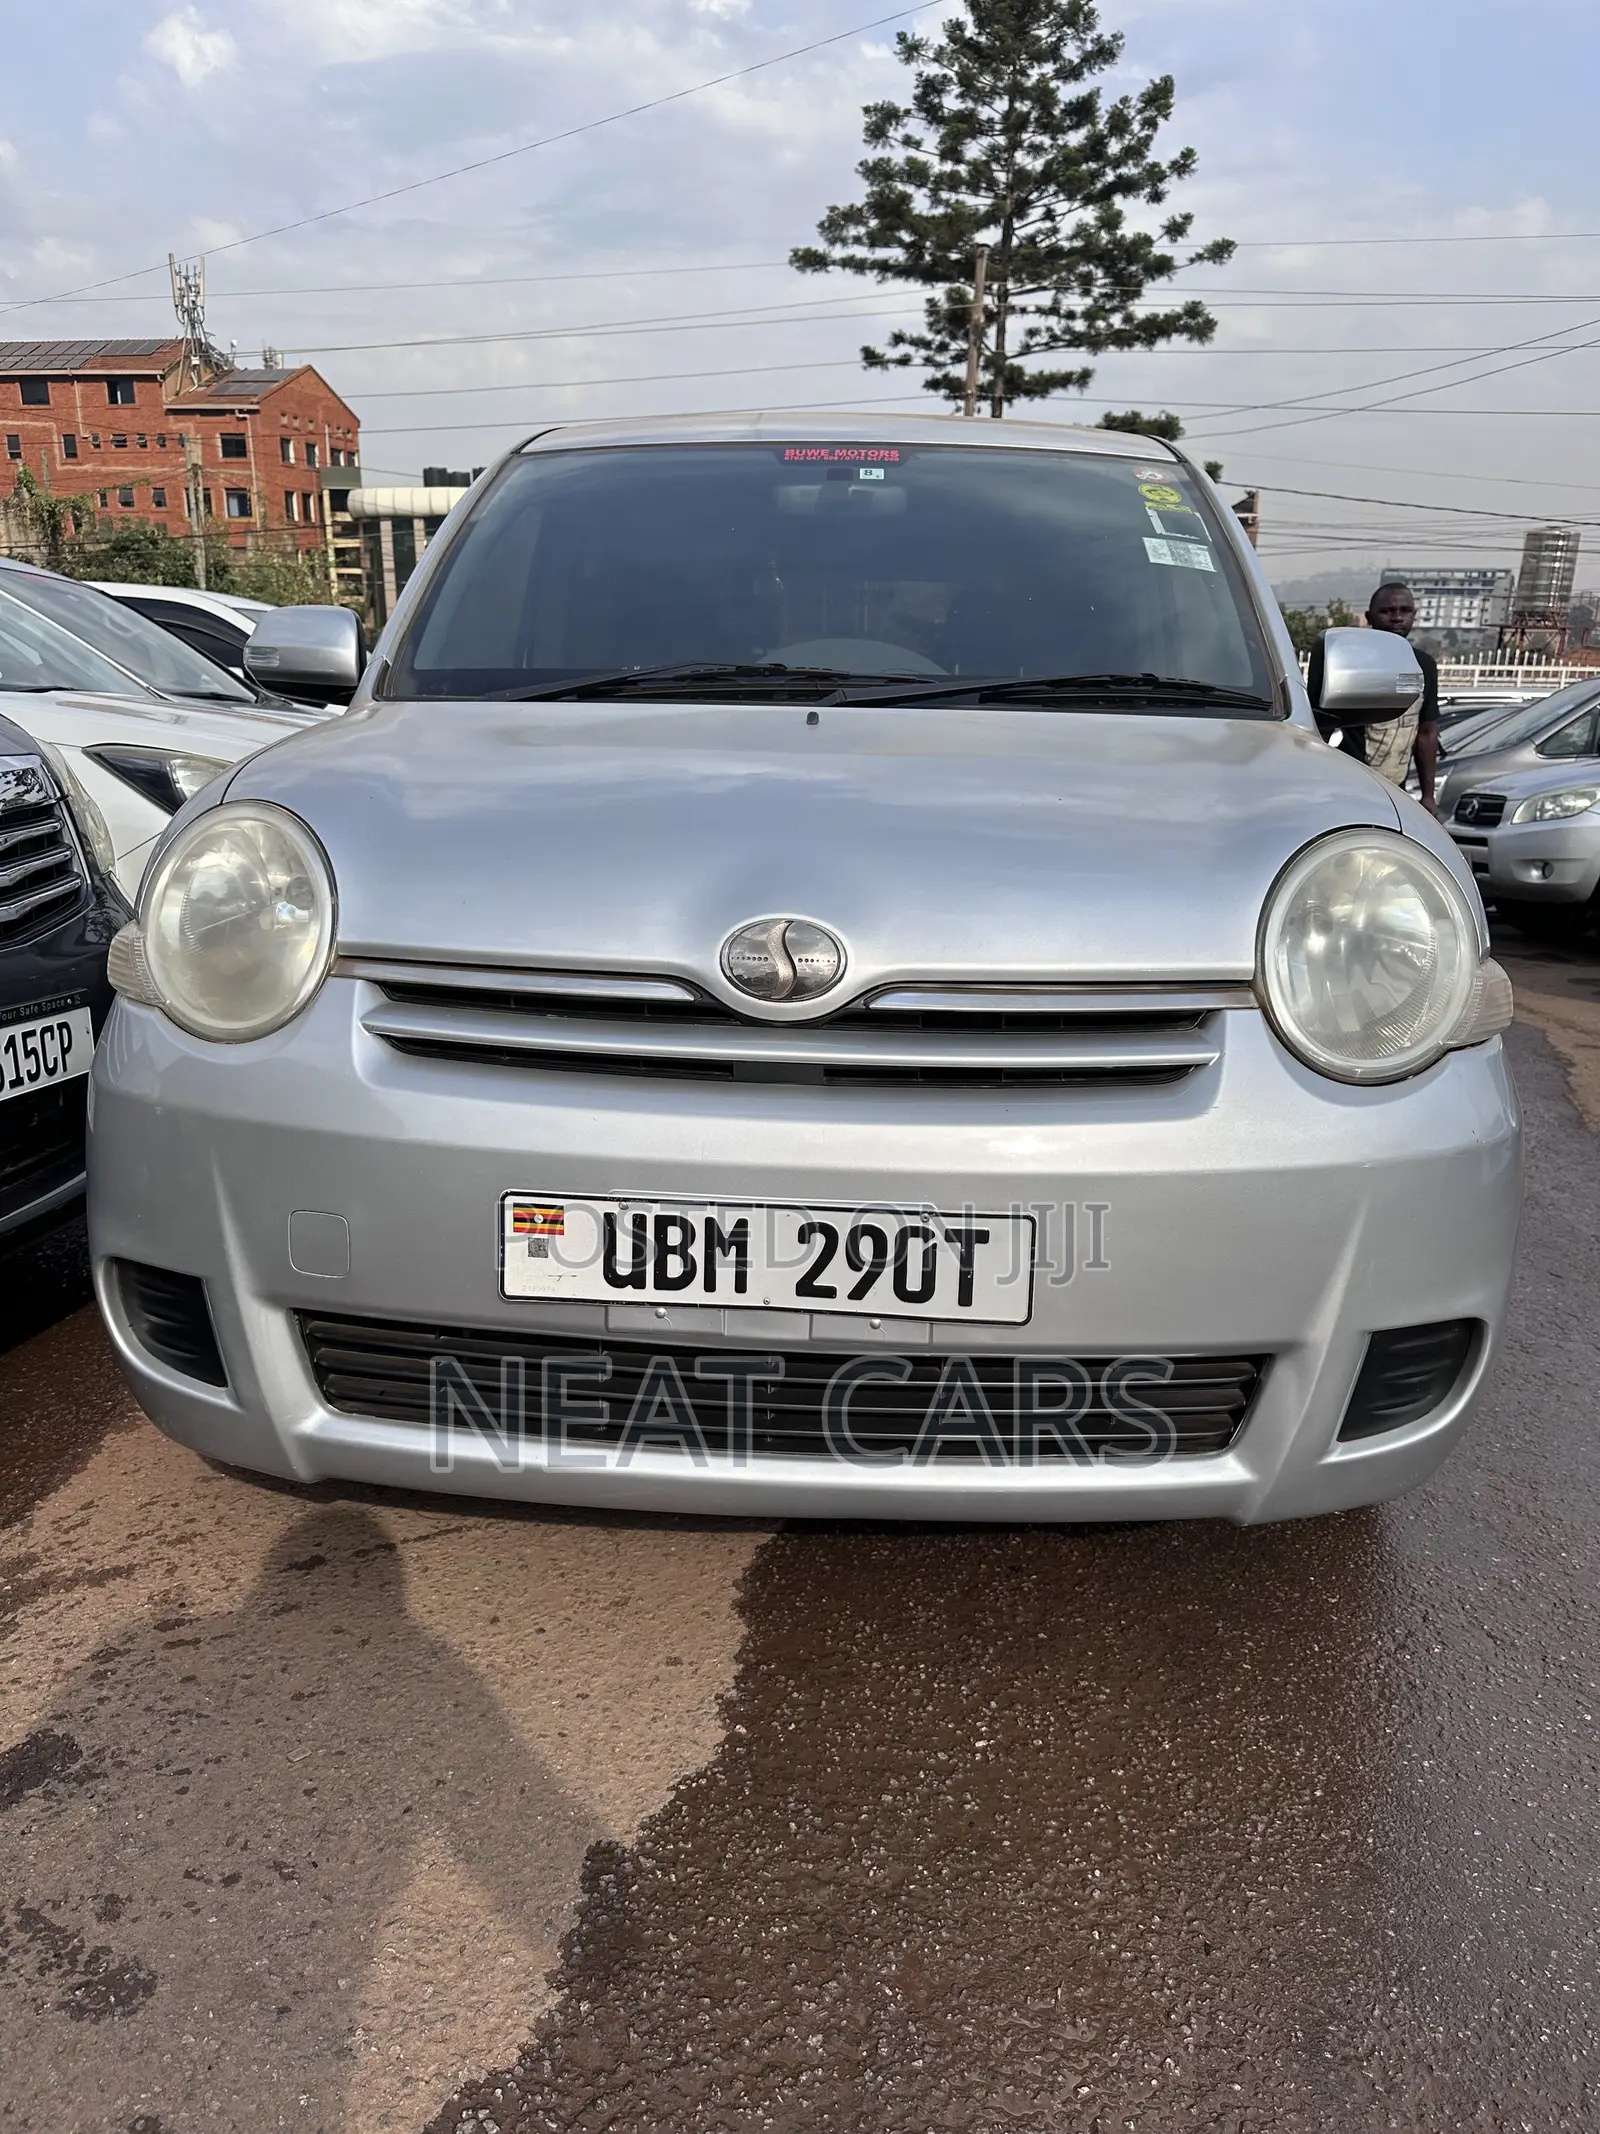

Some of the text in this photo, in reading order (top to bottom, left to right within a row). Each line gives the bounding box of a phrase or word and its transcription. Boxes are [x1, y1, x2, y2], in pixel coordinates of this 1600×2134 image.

[834, 449, 900, 457] MOTORS
[20, 1004, 39, 1016] Safe
[41, 1000, 65, 1012] Space
[0, 1021, 73, 1093] 15CP
[603, 1212, 990, 1307] UBM 290T
